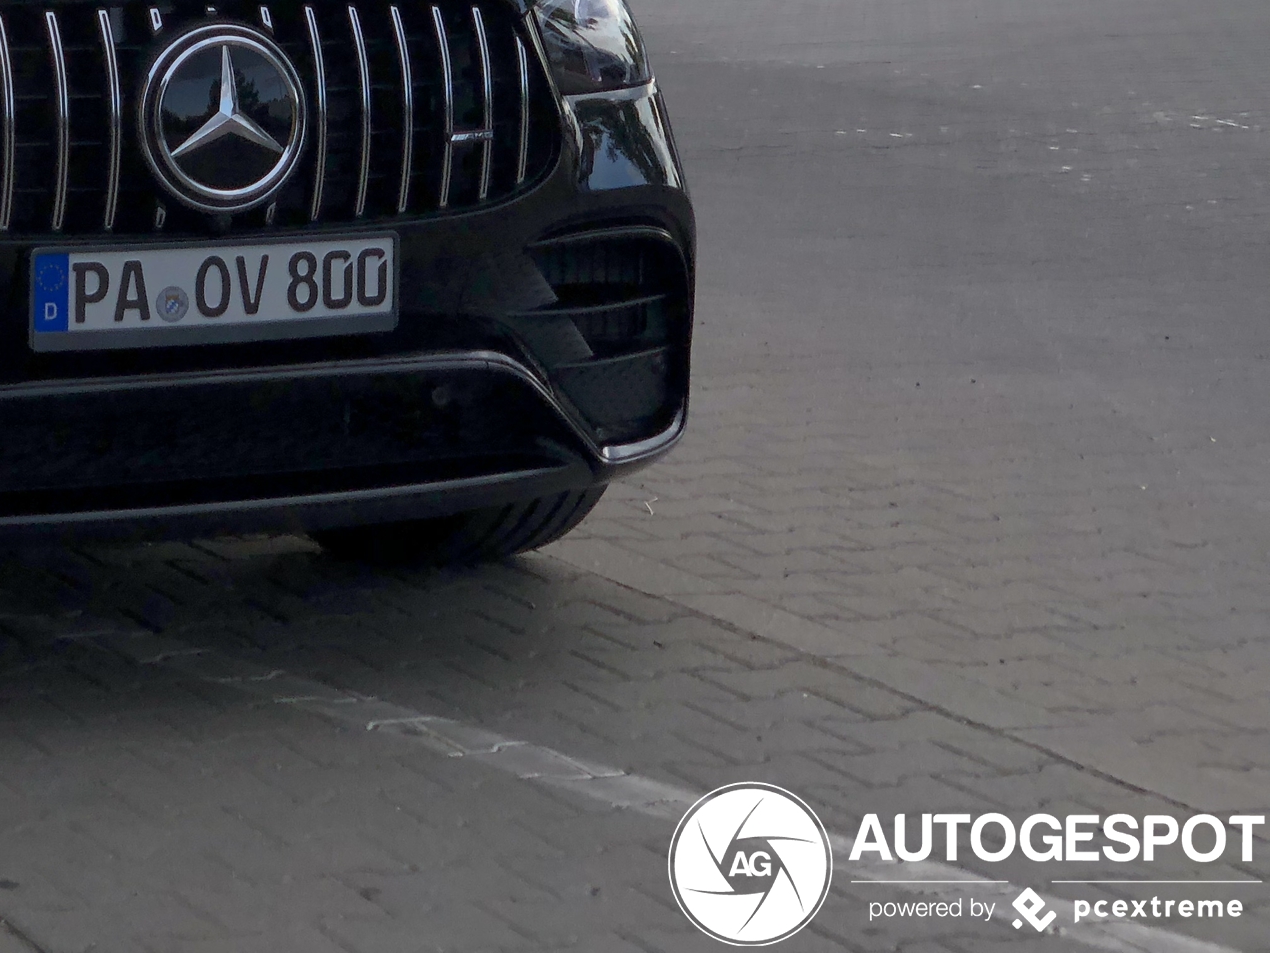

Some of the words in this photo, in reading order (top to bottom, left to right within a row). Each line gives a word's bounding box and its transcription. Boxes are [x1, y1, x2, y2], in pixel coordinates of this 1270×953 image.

[44, 302, 58, 320] D
[72, 259, 151, 324] PA
[195, 254, 270, 318] OV
[286, 247, 388, 313] 800
